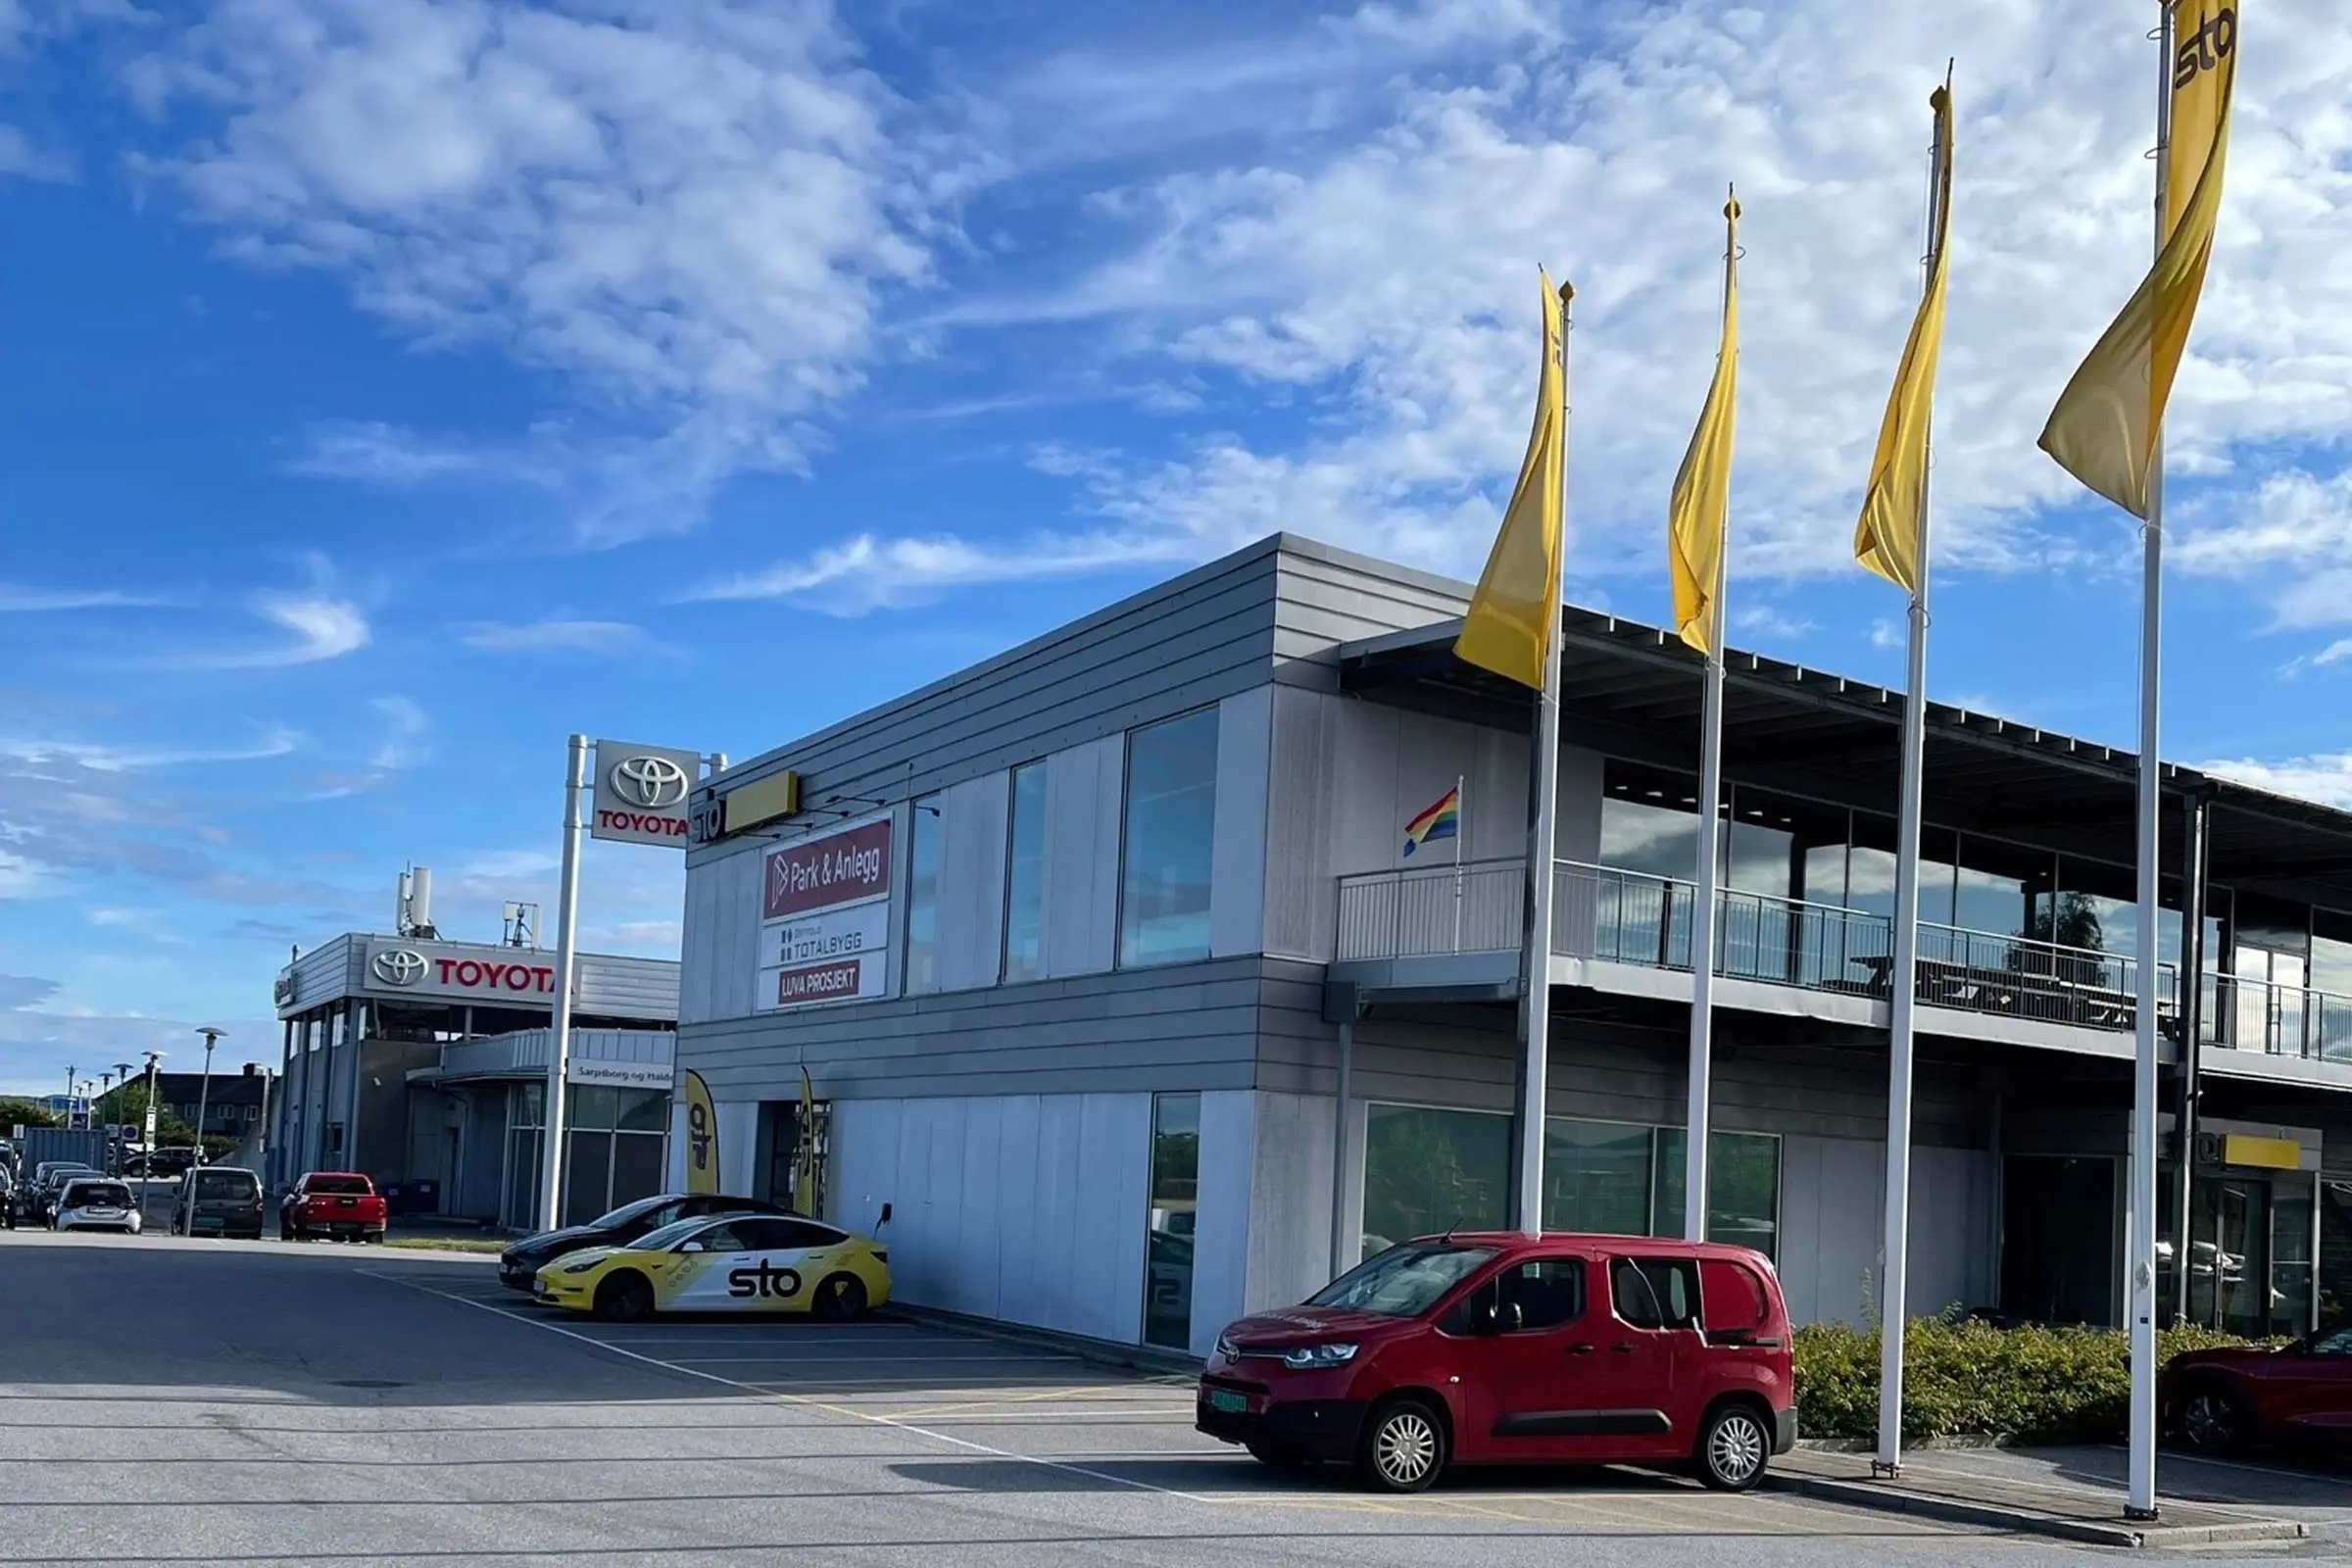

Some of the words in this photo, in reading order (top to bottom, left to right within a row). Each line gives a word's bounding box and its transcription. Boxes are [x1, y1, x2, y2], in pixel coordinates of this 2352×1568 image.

[2176, 8, 2237, 90] sto
[598, 809, 688, 836] TOYOTA
[790, 856, 819, 894] Park
[821, 852, 831, 885] &
[833, 845, 880, 884] Anlegg
[794, 932, 862, 958] TOTALBYGG
[807, 967, 857, 993] PROSJEKT
[631, 1072, 646, 1082] og
[729, 1257, 803, 1298] sto
